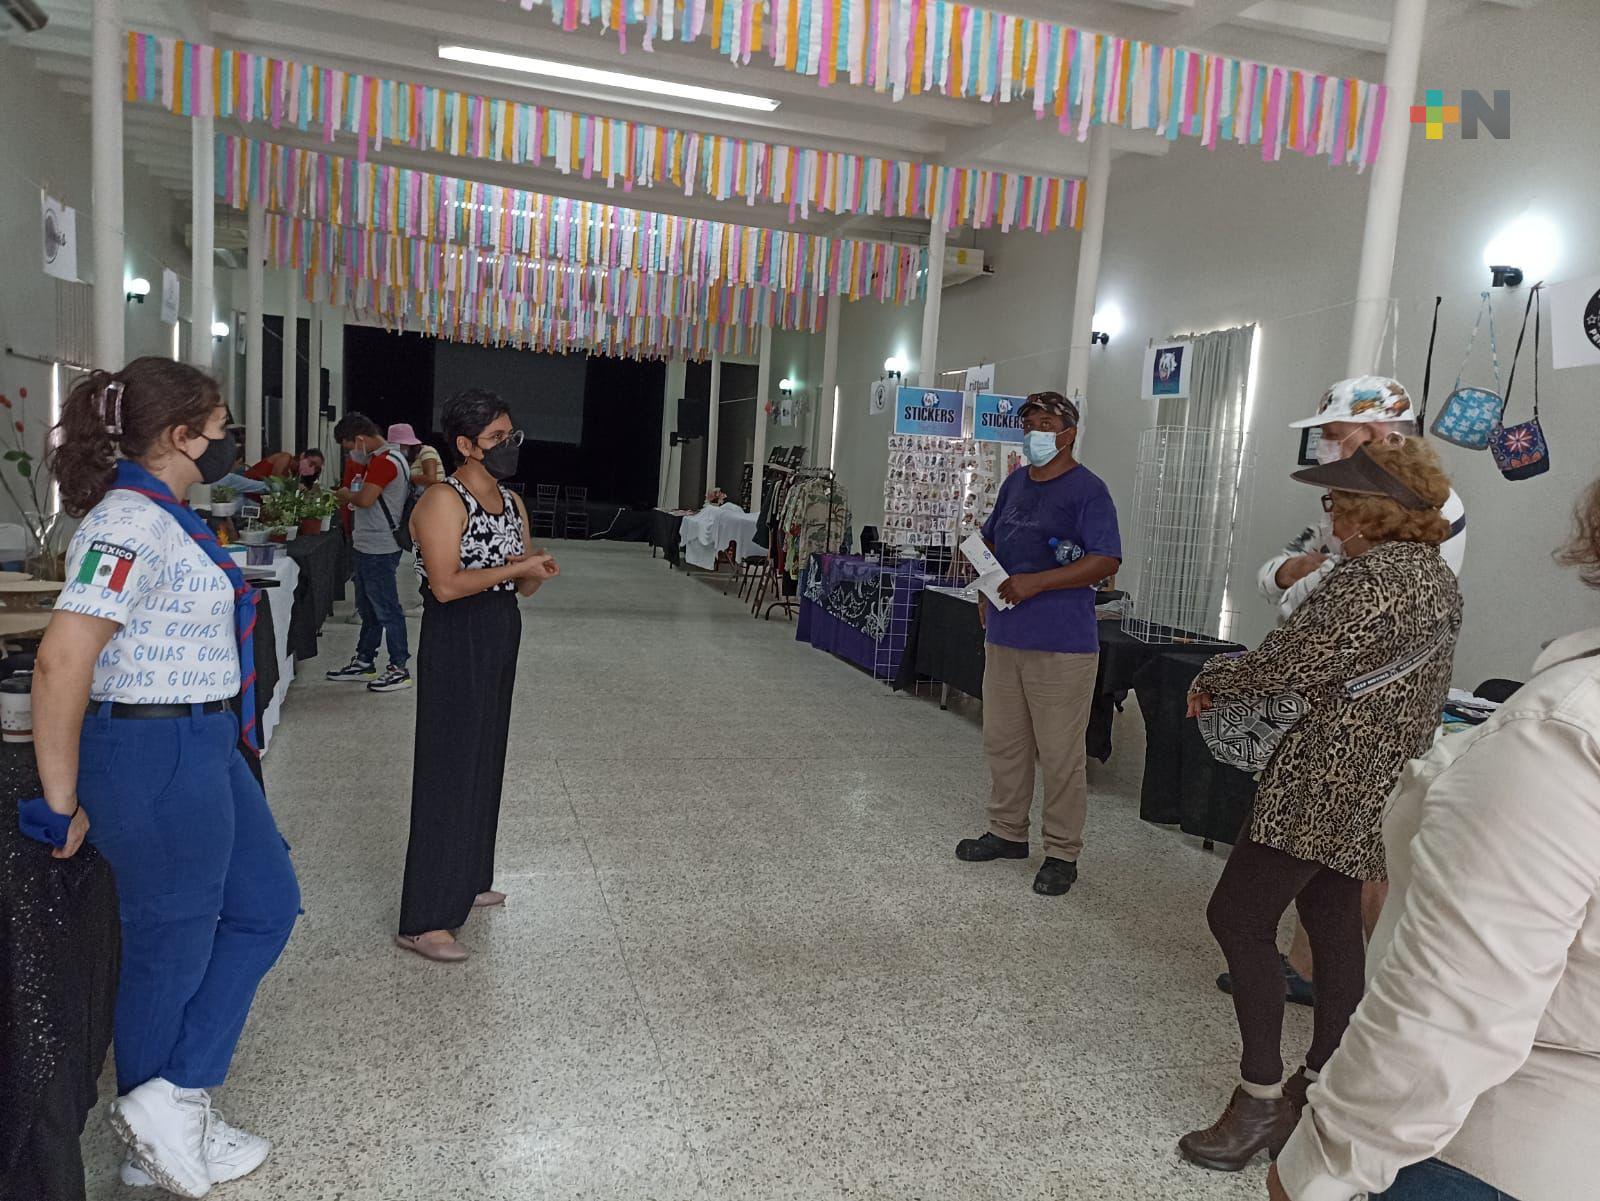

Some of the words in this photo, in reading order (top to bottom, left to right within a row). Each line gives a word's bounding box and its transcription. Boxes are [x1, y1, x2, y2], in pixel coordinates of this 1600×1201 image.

[904, 406, 955, 423] STICKERS
[981, 413, 1025, 429] STICKERS
[171, 575, 227, 592] GUIAS
[165, 622, 220, 638] GUIAS
[133, 644, 185, 661] GUIAS
[103, 671, 155, 692] GUIAS
[168, 670, 216, 686] GUIAS
